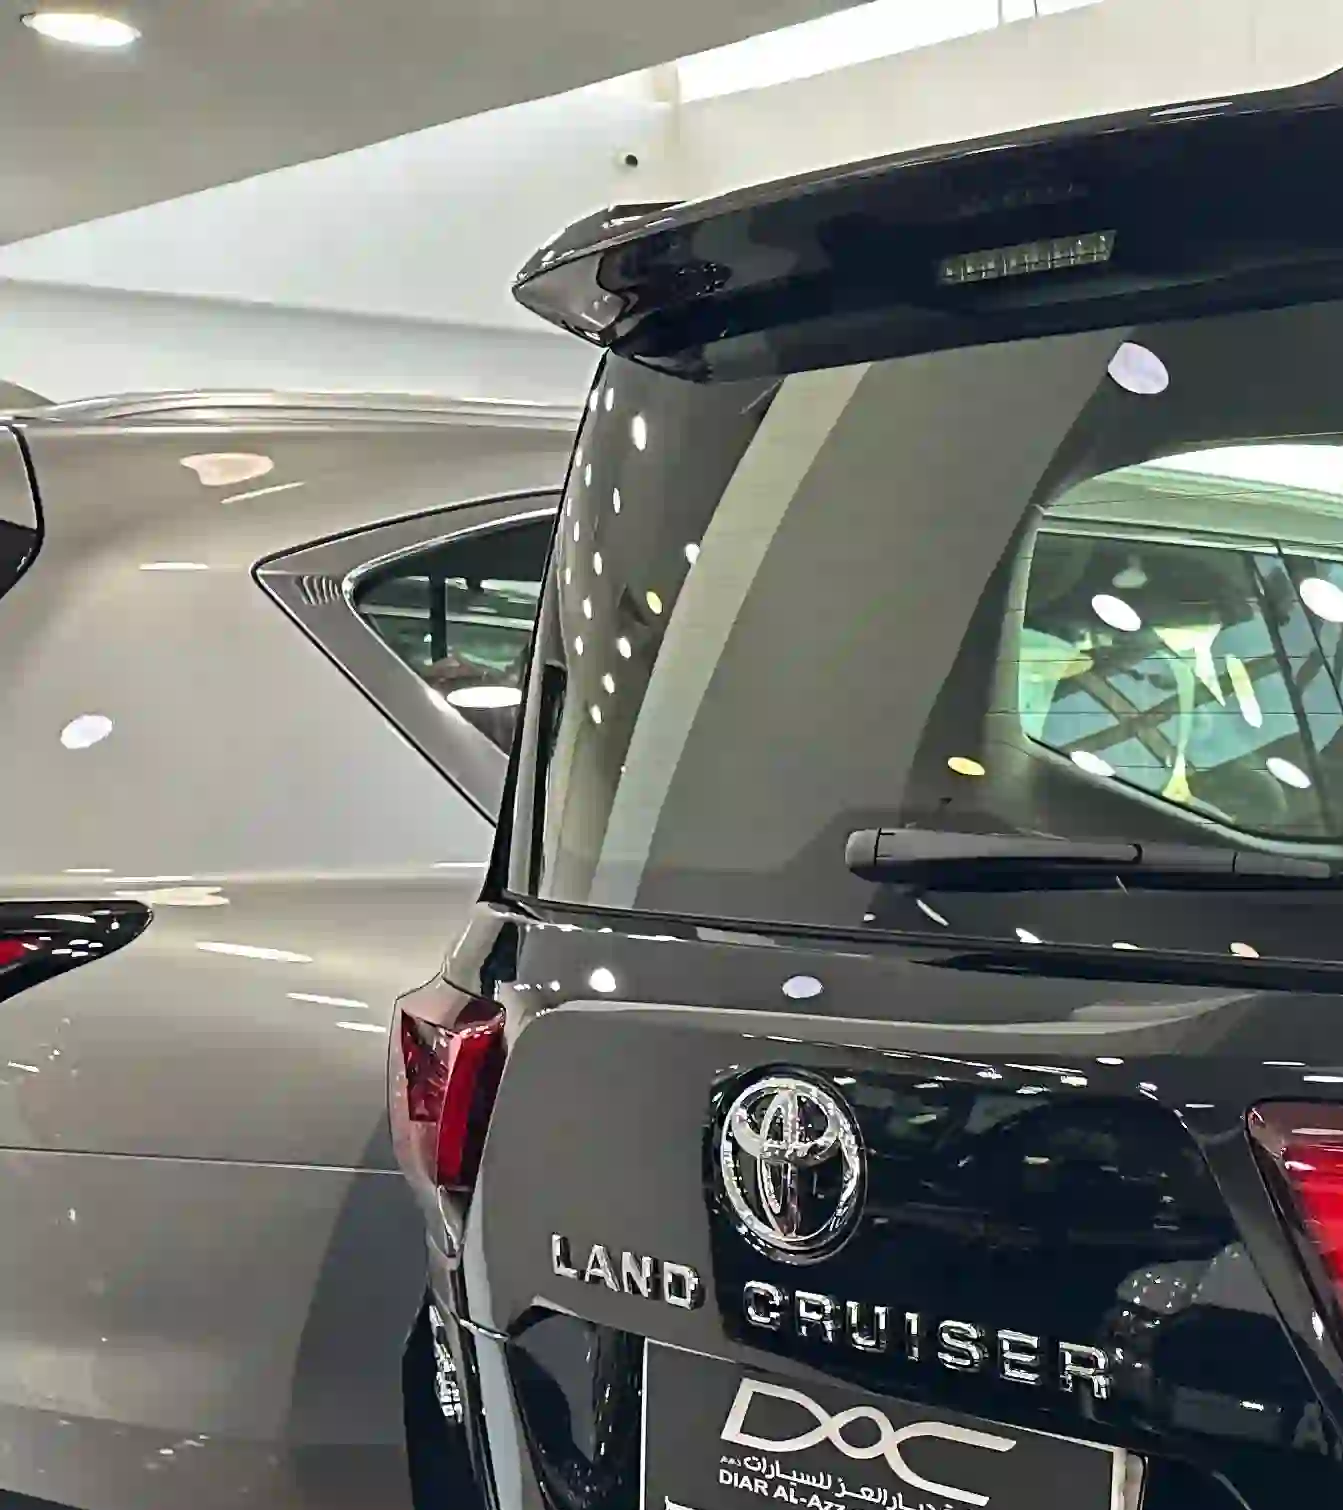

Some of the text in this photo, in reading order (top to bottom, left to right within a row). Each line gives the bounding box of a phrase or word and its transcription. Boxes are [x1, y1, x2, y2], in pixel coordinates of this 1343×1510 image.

[551, 1232, 1113, 1400] LAND CRUISER
[719, 1469, 769, 1497] DIAR
[743, 1456, 832, 1490] للسيارات
[834, 1476, 888, 1506] العز
